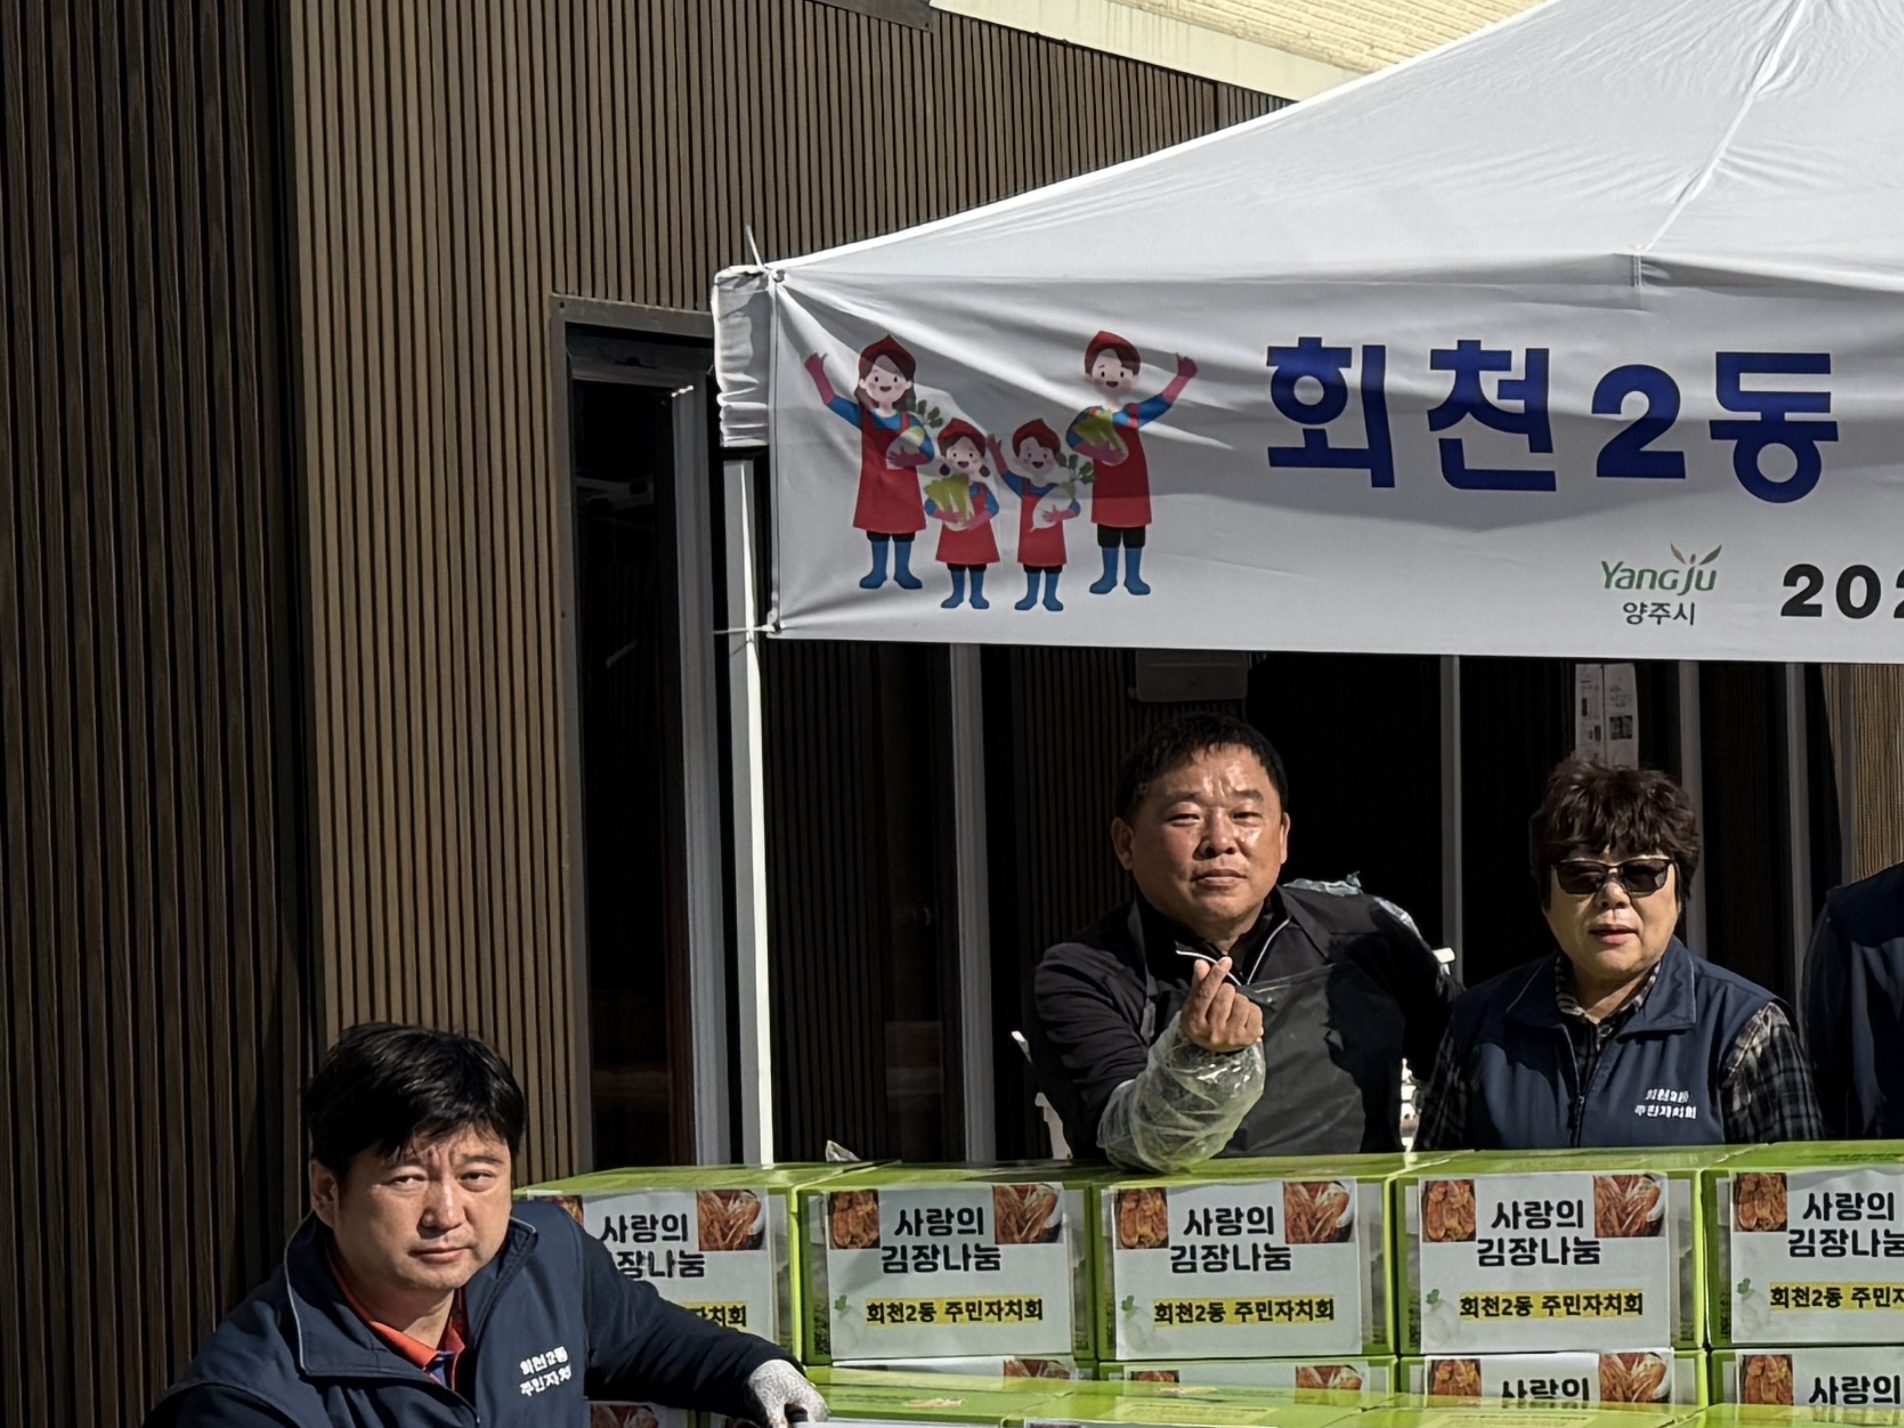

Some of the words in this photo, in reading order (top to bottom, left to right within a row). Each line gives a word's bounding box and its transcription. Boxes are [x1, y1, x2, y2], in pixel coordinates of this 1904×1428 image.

[1267, 337, 1839, 503] 회천2동
[1623, 602, 1695, 625] 양주시
[1491, 1201, 1583, 1229] 사랑의
[1803, 1192, 1894, 1221] 사랑의
[894, 1209, 983, 1237] 사랑의
[1184, 1209, 1274, 1236] 사랑의
[881, 1243, 1000, 1273] 김장나눔
[1170, 1243, 1291, 1273] 김장나눔
[1478, 1236, 1600, 1266] 김장나눔
[867, 1302, 936, 1324] 회천2동
[945, 1299, 1042, 1322] 주민자치회
[1155, 1303, 1226, 1324] 회천2동
[1234, 1299, 1334, 1322] 주민자치회
[1460, 1296, 1533, 1318] 회천2동
[1542, 1293, 1642, 1316] 주민자치회
[1770, 1287, 1843, 1308] 회천2동
